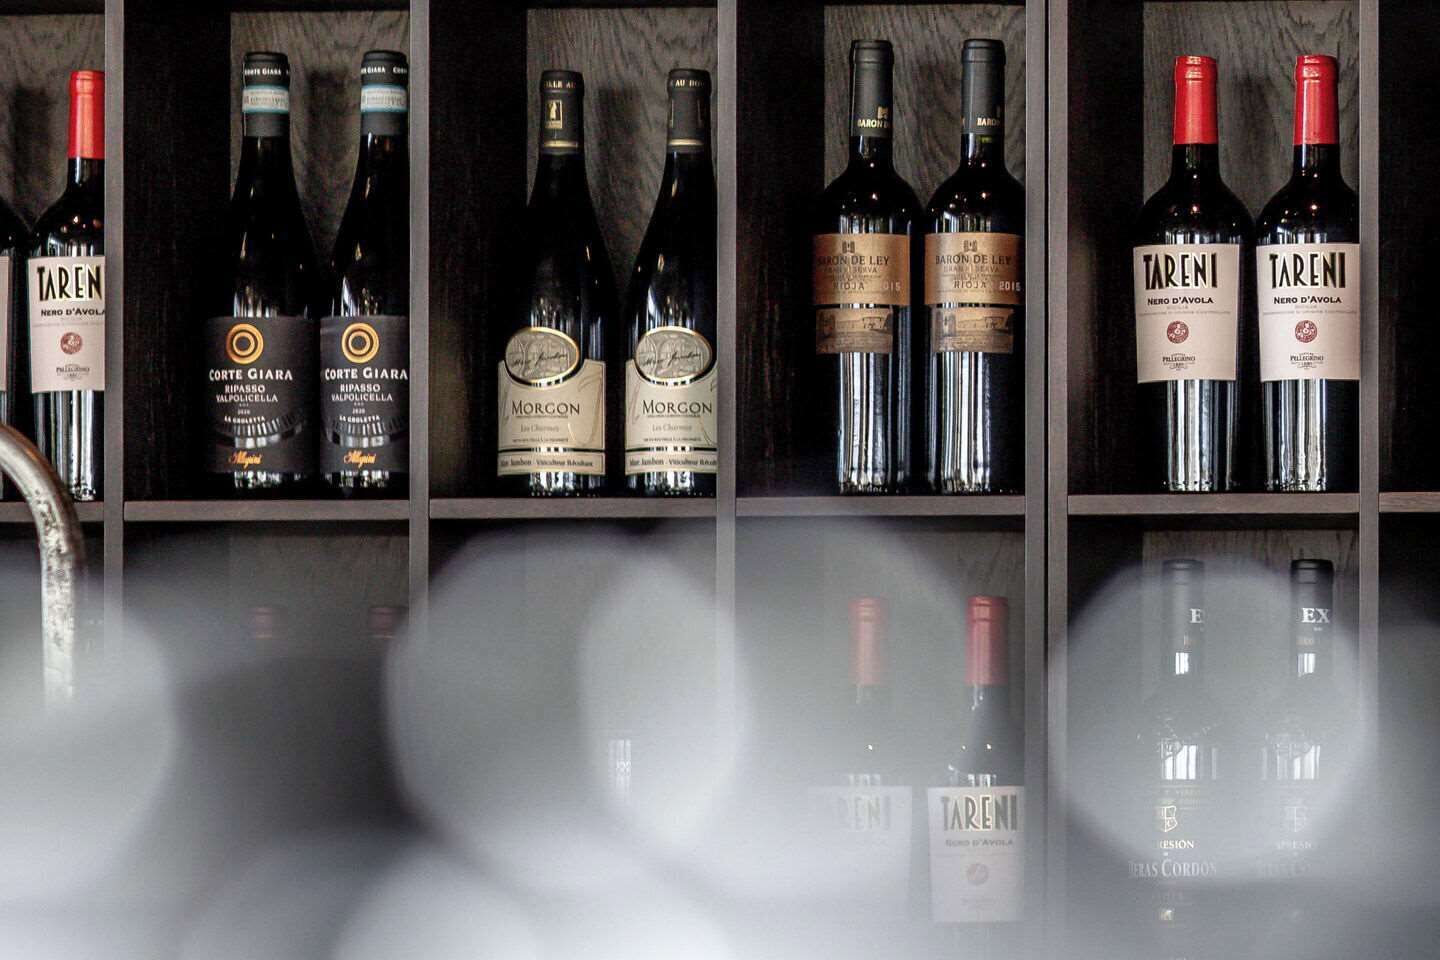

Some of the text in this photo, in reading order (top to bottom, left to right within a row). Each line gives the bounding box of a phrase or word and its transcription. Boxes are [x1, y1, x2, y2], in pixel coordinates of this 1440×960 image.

[850, 255, 890, 265] DE LEY
[935, 255, 1011, 265] BARON DE LEY
[1143, 253, 1217, 290] TARENI
[1269, 252, 1345, 289] TARENI
[37, 265, 102, 301] TAREN
[953, 280, 986, 289] RIOJA
[1147, 297, 1169, 305] NERO
[1273, 296, 1298, 304] NERO
[41, 309, 63, 317] NERO
[209, 367, 293, 381] CORTE GIARA
[324, 367, 408, 380] CORTE GIARA
[224, 385, 266, 393] RIPASSO
[340, 384, 381, 393] RIPASSO
[216, 394, 278, 403] VALPOLICELLA
[331, 393, 393, 402] VALPOLICELLA
[511, 399, 580, 415] MORGON
[642, 399, 712, 415] MORGON
[1301, 607, 1331, 623] EX
[940, 794, 1018, 831] TARENI
